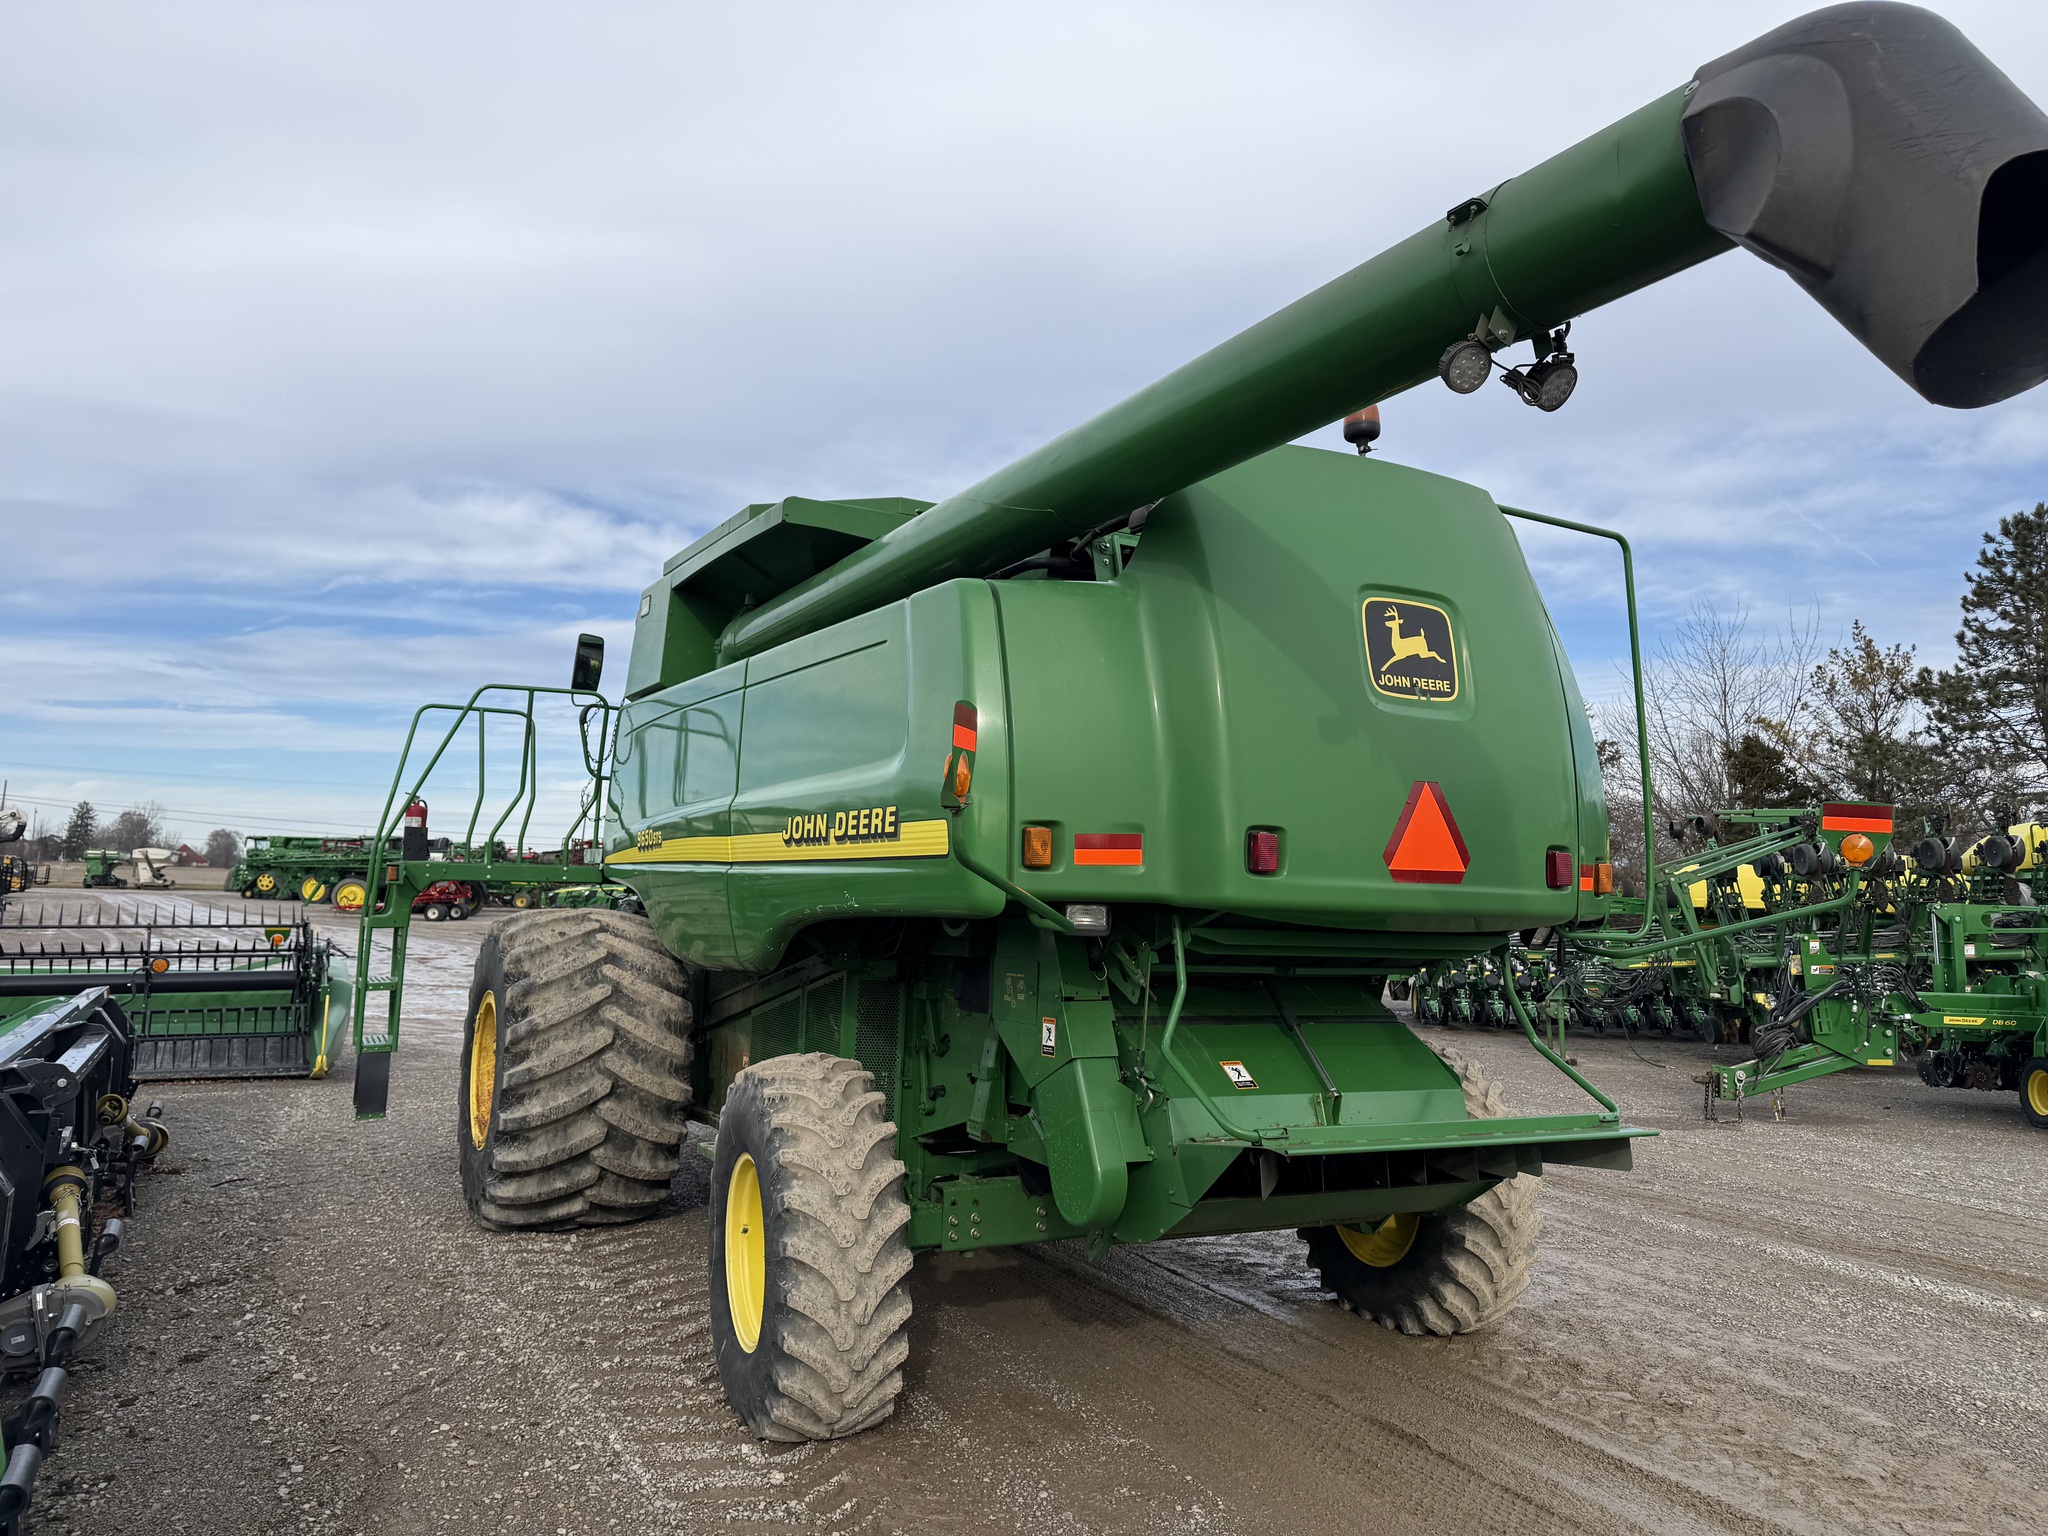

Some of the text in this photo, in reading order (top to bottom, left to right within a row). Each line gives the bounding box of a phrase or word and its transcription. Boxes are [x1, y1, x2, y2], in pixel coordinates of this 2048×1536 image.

[1378, 674, 1411, 688] JOHN
[782, 805, 899, 844] JOHN DEERE
